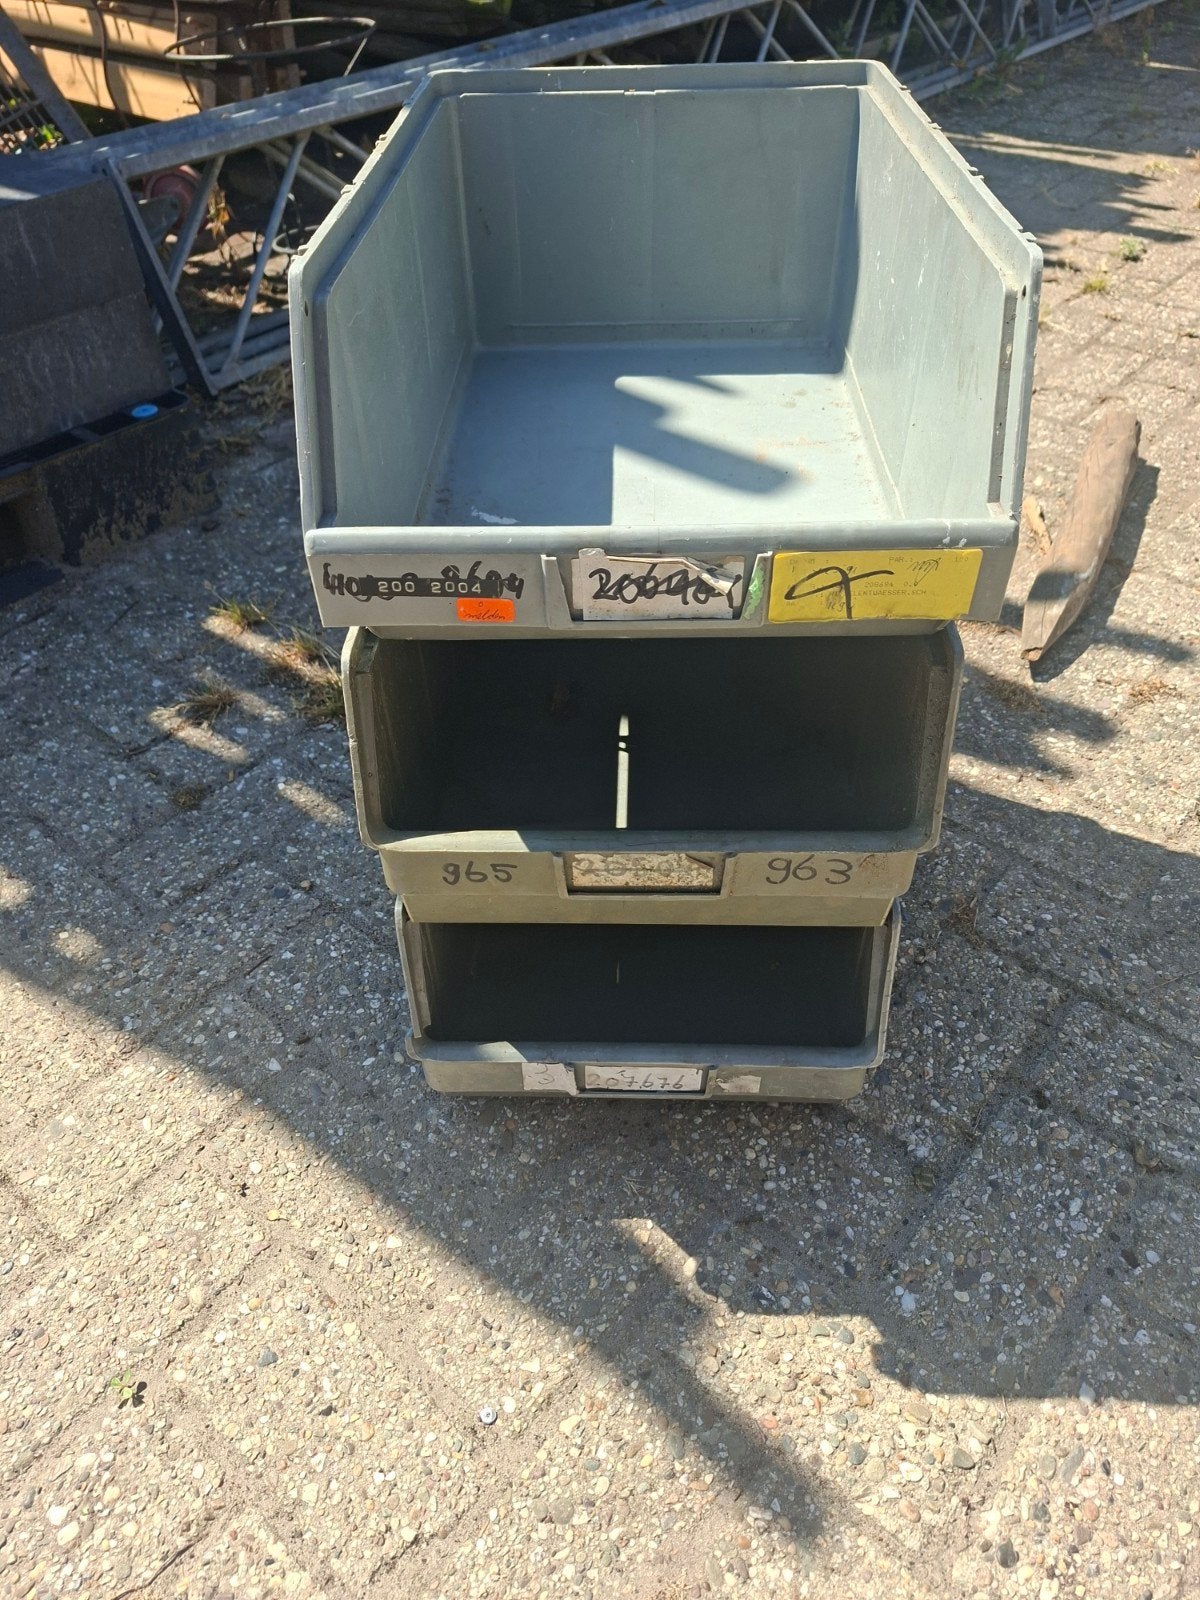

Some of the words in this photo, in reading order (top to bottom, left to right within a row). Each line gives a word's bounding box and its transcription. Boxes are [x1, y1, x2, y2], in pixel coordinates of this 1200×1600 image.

[377, 580, 415, 593] 200
[430, 581, 482, 594] 2004
[442, 861, 518, 886] 965
[765, 853, 854, 885] 963
